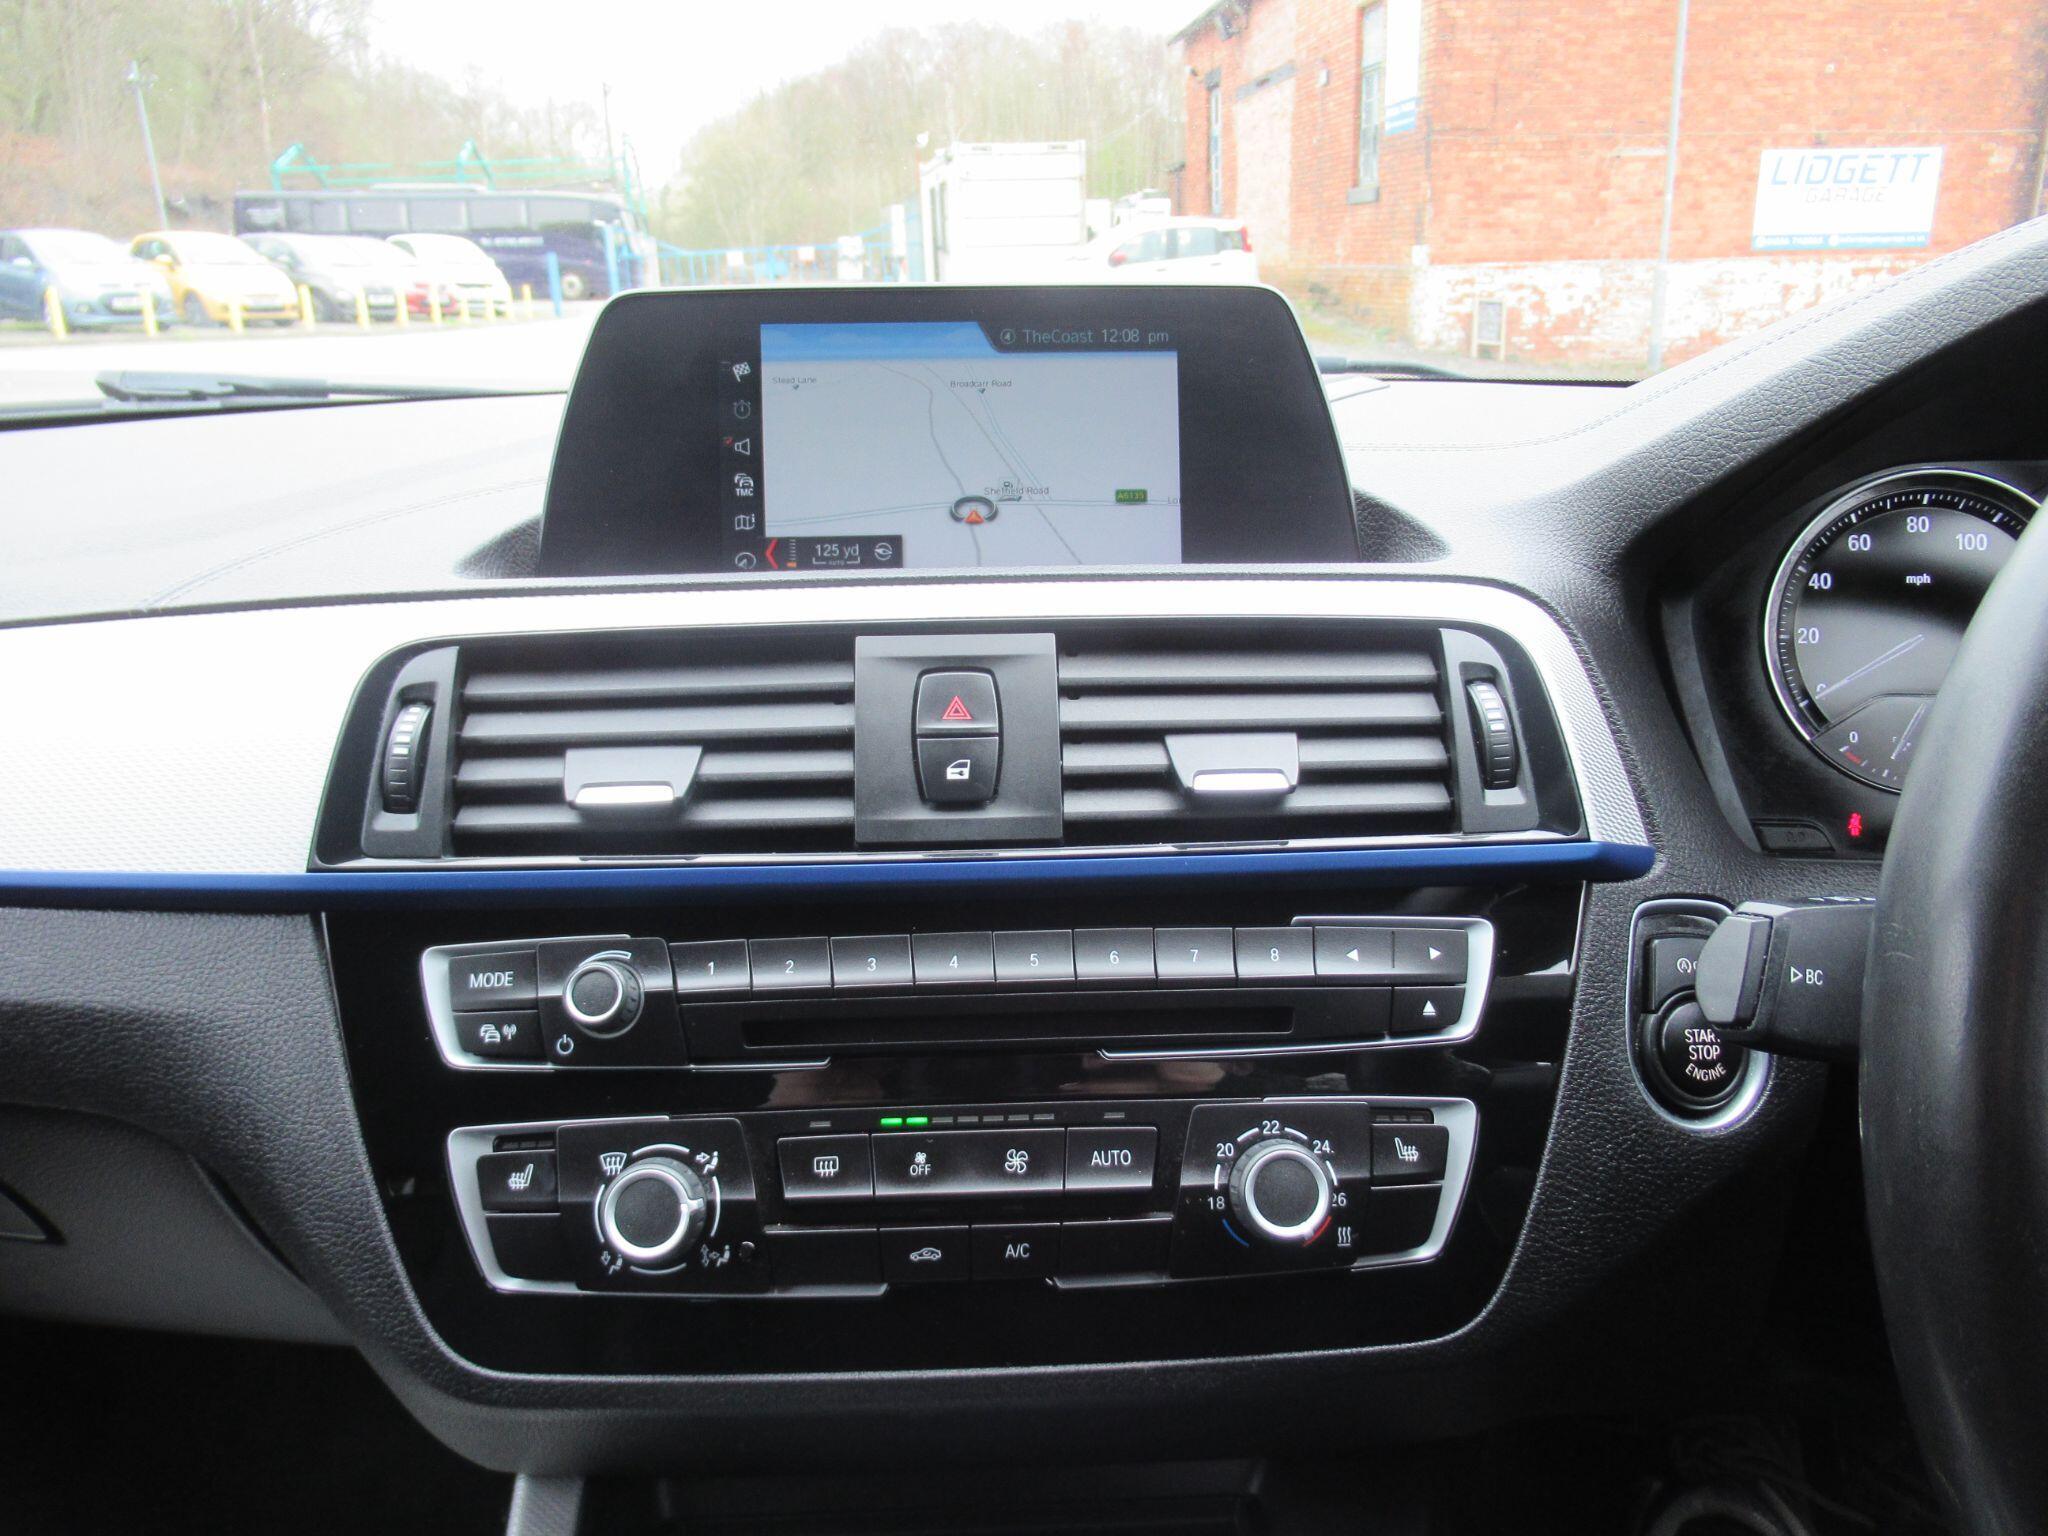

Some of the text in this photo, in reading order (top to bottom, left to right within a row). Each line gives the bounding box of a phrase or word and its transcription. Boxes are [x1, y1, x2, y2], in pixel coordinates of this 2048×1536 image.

[1771, 153, 1932, 185] LIDGETT
[1805, 186, 1888, 203] GARAGE
[1023, 329, 1169, 345] TheCoast 12:08 pm
[991, 380, 1012, 388] Road
[735, 488, 754, 496] TMC
[1026, 486, 1049, 496] Road
[1906, 515, 1930, 533] 80
[1848, 534, 1871, 552] 60
[1955, 533, 1988, 551] 100
[815, 544, 859, 559] 125 yd
[1808, 572, 1832, 590] 40
[1906, 573, 1931, 586] mph
[1797, 628, 1819, 644] 20
[1849, 731, 1858, 744] 0
[1029, 953, 1039, 967] 5
[1109, 950, 1120, 965] 6
[1190, 949, 1199, 964] 7
[1269, 948, 1279, 962] 8
[707, 961, 715, 976] 1
[785, 959, 795, 974] 2
[867, 957, 877, 972] 3
[949, 956, 960, 970] 4
[469, 971, 514, 989] MODE
[1805, 968, 1823, 986] BC
[1684, 1028, 1721, 1044] STAR
[1688, 1045, 1721, 1060] STOP
[1685, 1062, 1727, 1082] ENGINE
[1262, 1120, 1281, 1135] 22
[1216, 1143, 1234, 1157] 20
[1313, 1139, 1331, 1154] 24
[1091, 1149, 1132, 1167] AUTO
[909, 1163, 931, 1176] OFF
[1207, 1196, 1225, 1210] 18
[1332, 1194, 1347, 1207] 26
[1005, 1243, 1030, 1259] A/C
